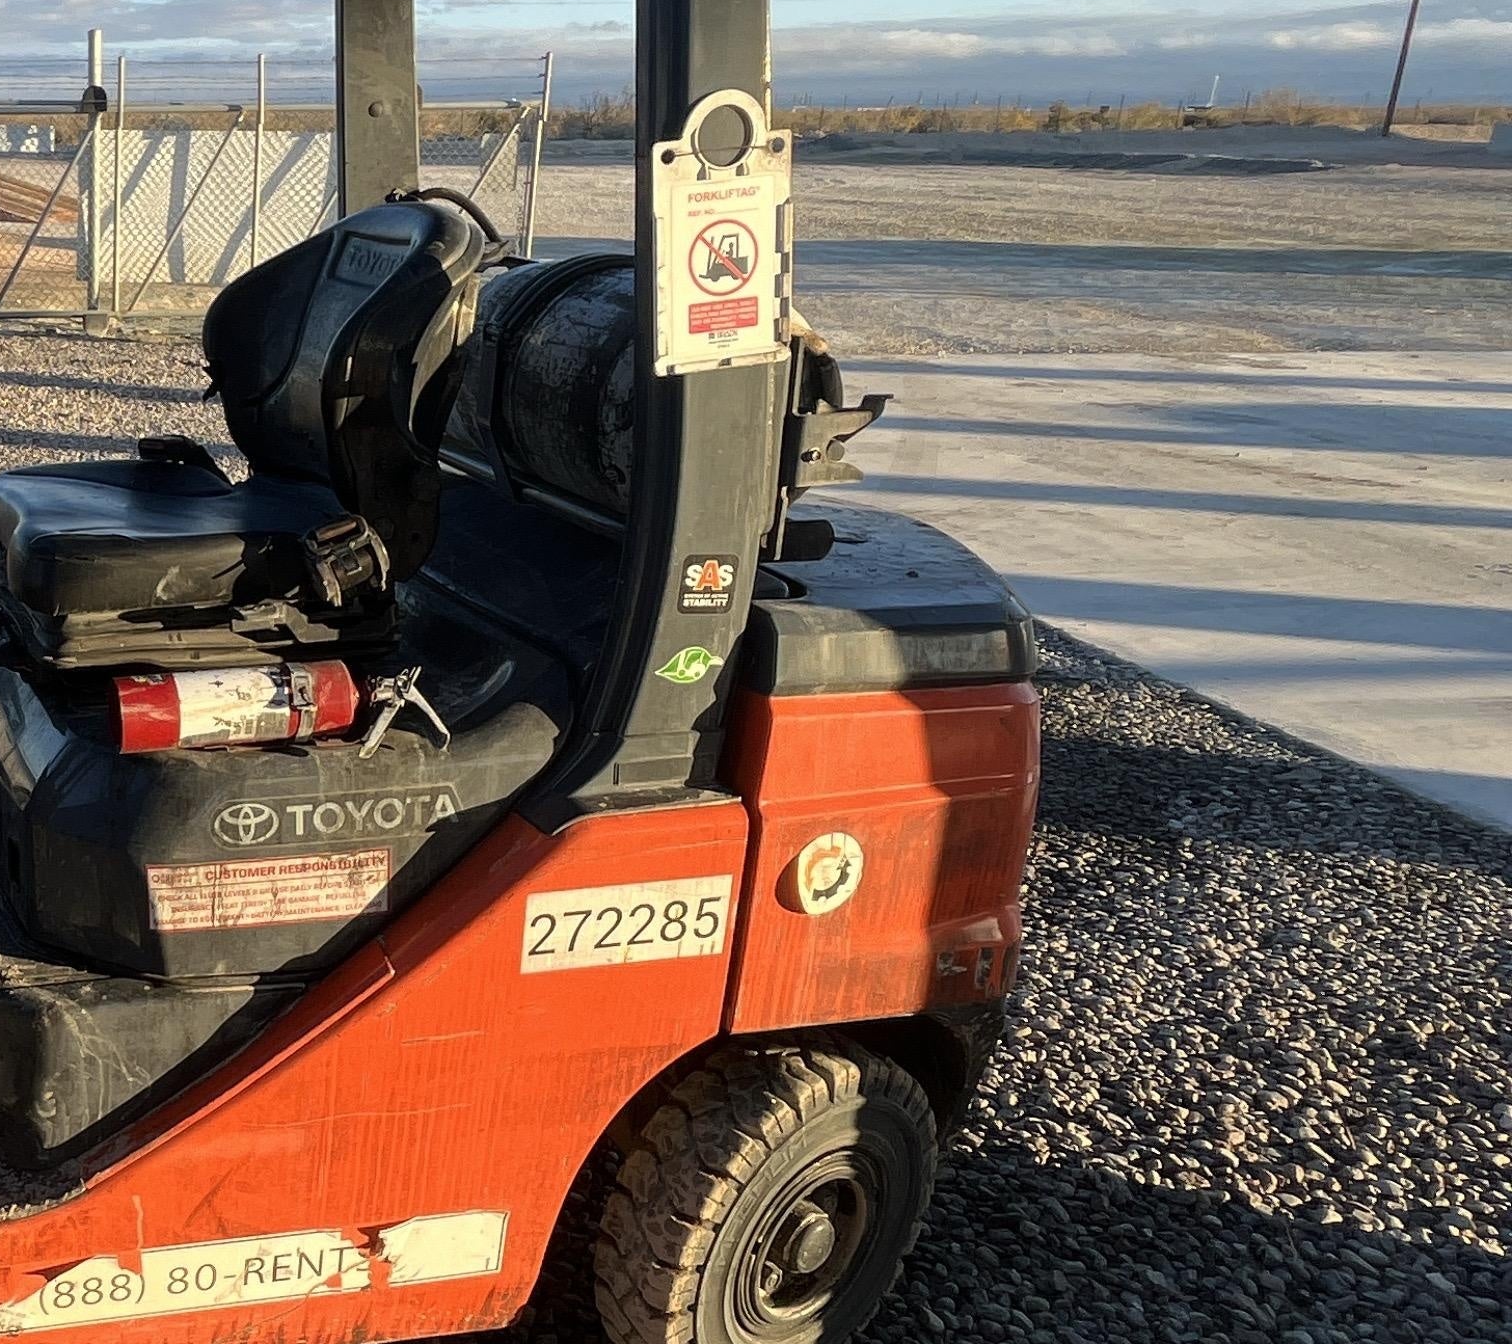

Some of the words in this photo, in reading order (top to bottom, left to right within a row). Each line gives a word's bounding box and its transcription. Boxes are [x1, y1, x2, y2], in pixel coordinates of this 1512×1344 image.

[684, 559, 735, 591] SAS
[683, 598, 729, 607] STABILITY
[285, 793, 459, 836] TOYOTA
[205, 866, 276, 882] CUSTOMER
[278, 855, 386, 875] RESPONSIBILITY
[527, 895, 723, 958] 272285
[39, 1272, 146, 1316] (888)
